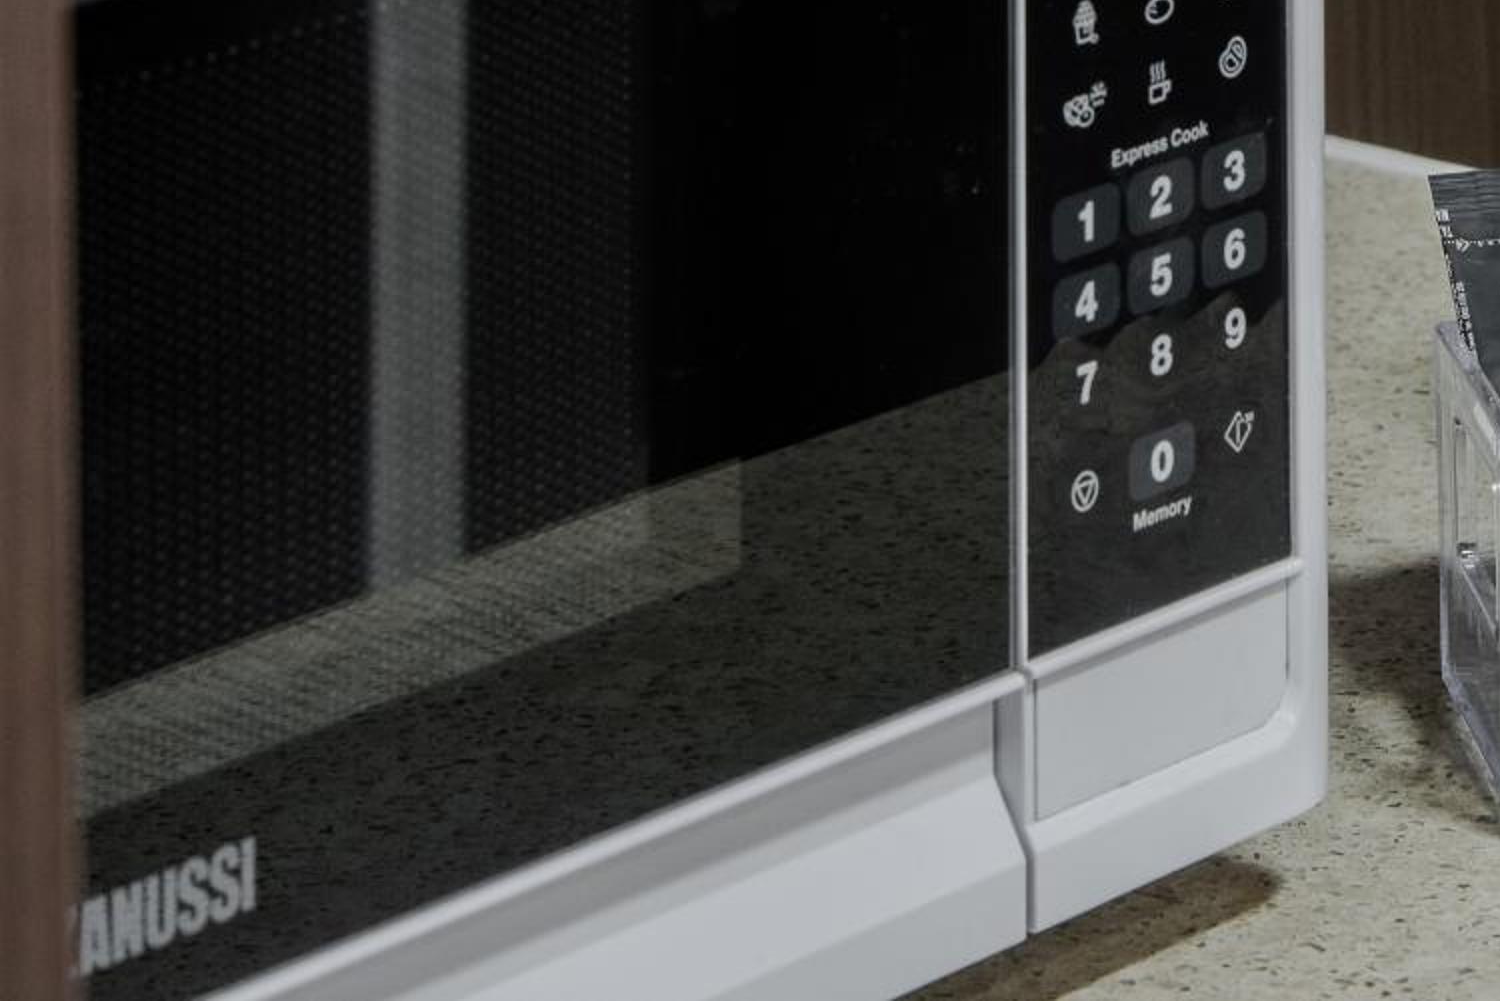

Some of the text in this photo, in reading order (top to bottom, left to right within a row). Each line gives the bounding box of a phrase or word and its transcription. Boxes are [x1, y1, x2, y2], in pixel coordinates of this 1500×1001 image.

[1110, 120, 1209, 169] Express Cook
[1223, 150, 1246, 191] 3
[1150, 175, 1173, 219] 2
[1077, 200, 1095, 242] 1
[1223, 228, 1247, 270] 6
[1150, 252, 1173, 296] 5
[1074, 280, 1098, 322] 4
[1224, 307, 1247, 349] 9
[1150, 334, 1173, 376] 8
[1075, 360, 1098, 405] 7
[1151, 440, 1174, 482] 0
[1132, 497, 1192, 532] Memory
[72, 836, 256, 978] ANUSSI
